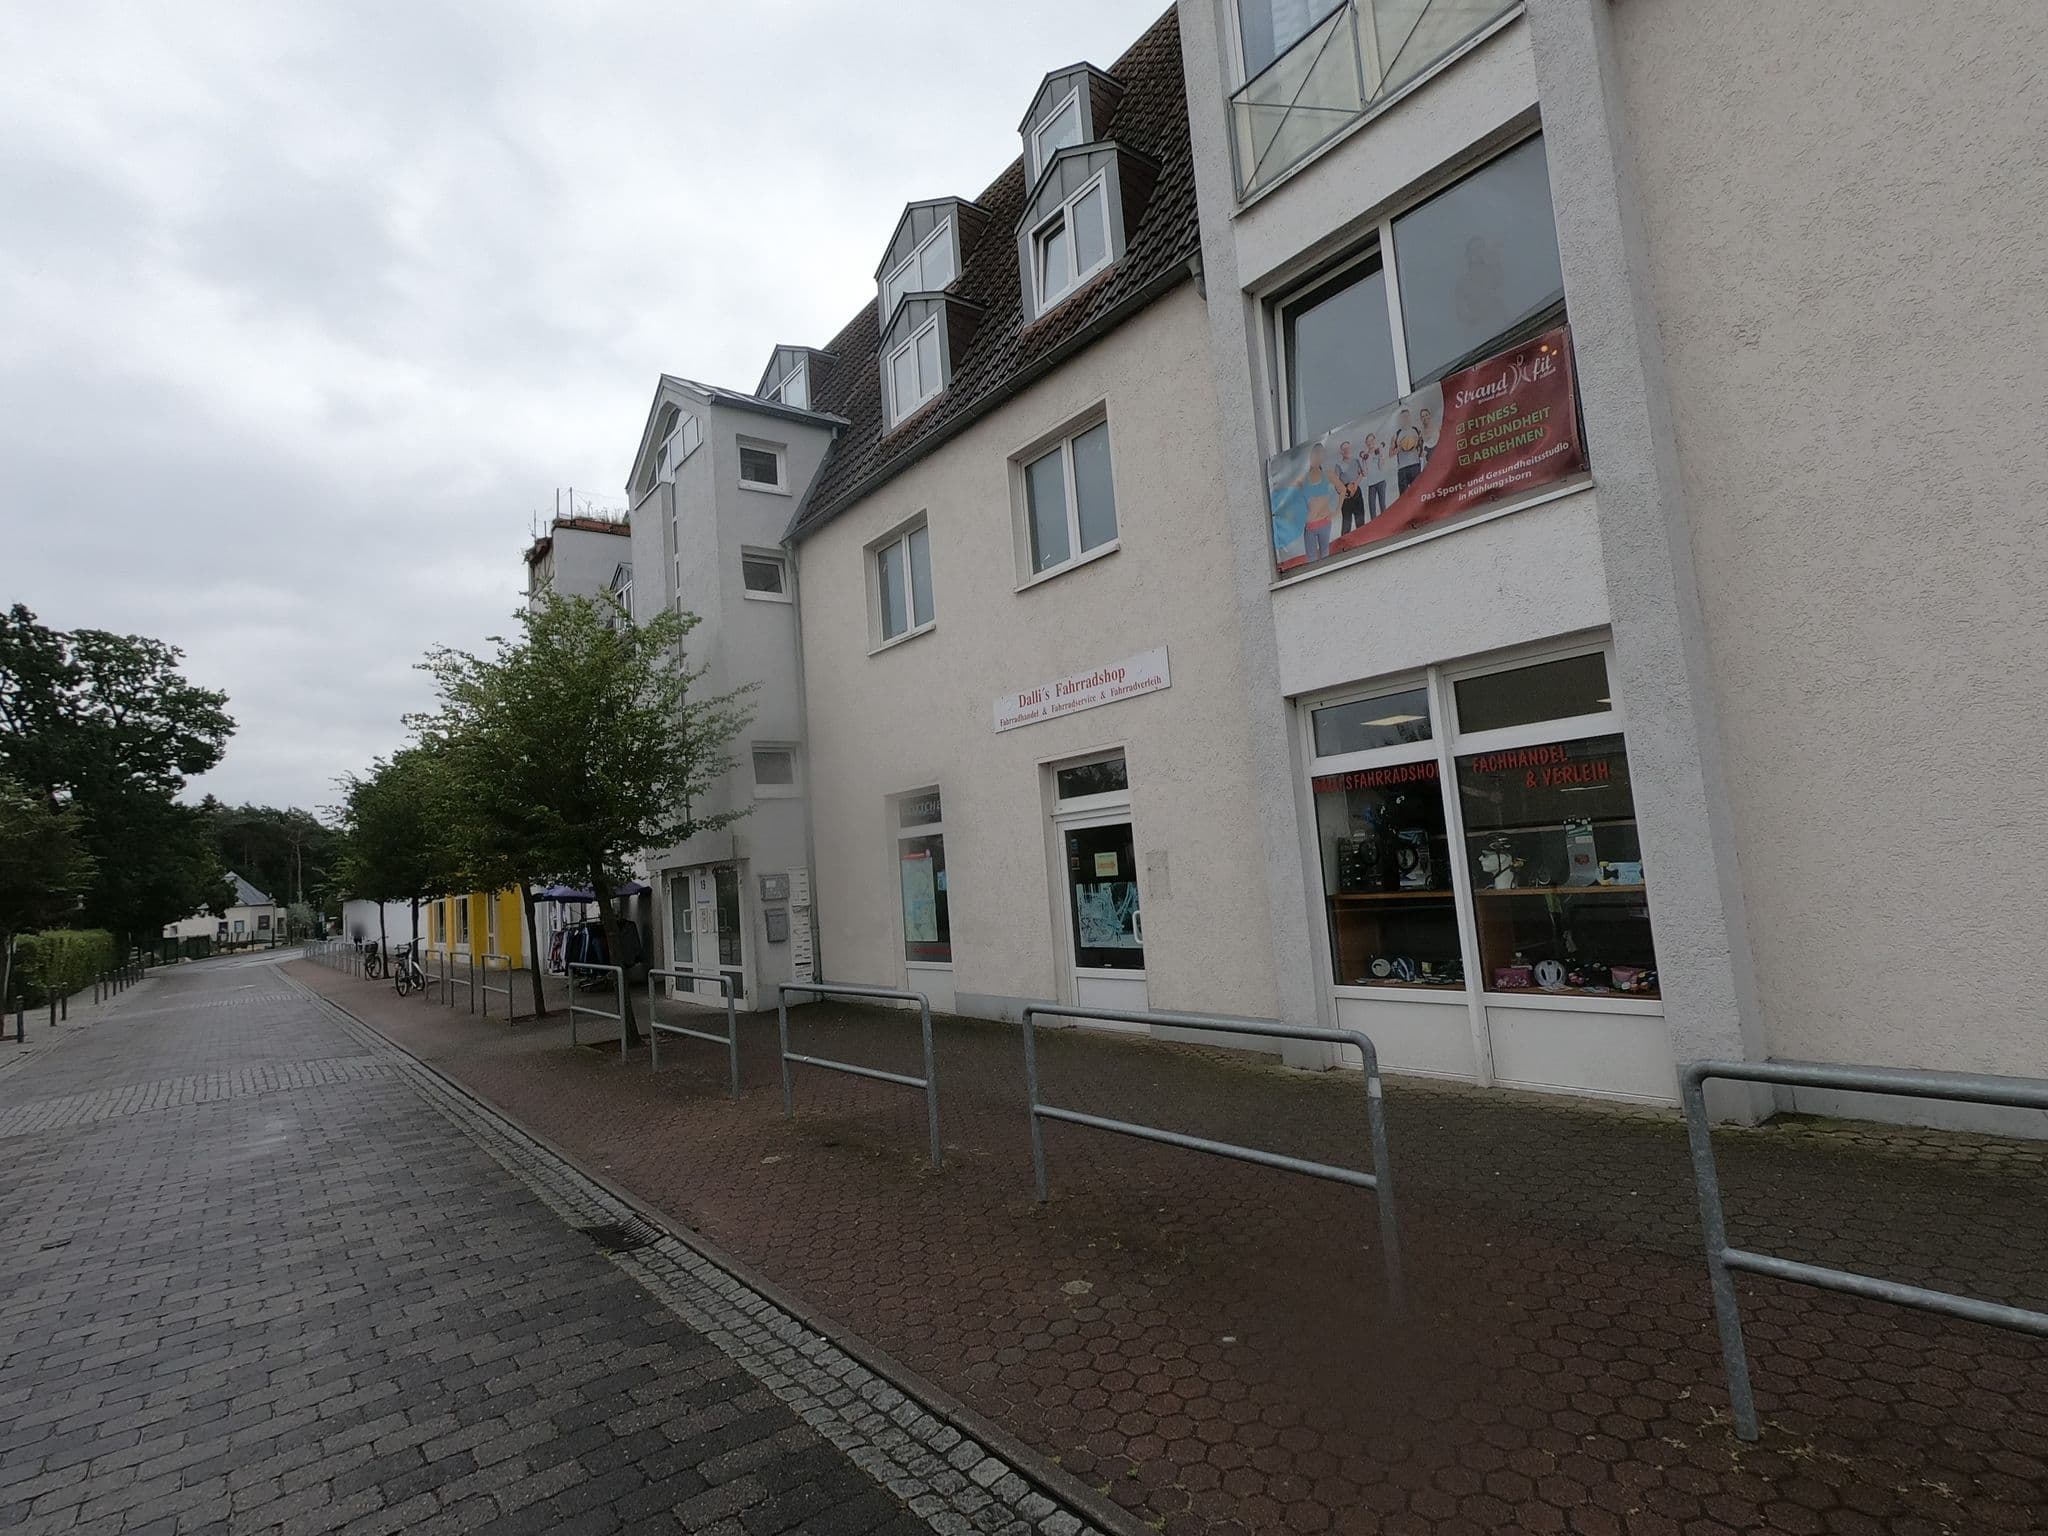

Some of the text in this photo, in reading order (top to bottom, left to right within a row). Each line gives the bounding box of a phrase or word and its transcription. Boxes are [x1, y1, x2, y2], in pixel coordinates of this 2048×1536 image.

[1455, 372, 1508, 408] Strand
[1533, 354, 1553, 382] fit
[1467, 402, 1519, 431] FITNESS
[1470, 407, 1551, 446] GESUNDHEIT
[1473, 428, 1544, 463] ABNEHMEN
[1420, 442, 1569, 502] Das Sport- und Gesundheitsstudio
[1458, 470, 1532, 501] in Kühlungsborn
[1055, 667, 1126, 697] Fahrradshop
[1000, 675, 1162, 727] Fahrradhandel & Fahrradservice & Fahrradverleih
[1472, 743, 1568, 774] FACHHANDEL
[1525, 760, 1610, 789] & VERLEIH
